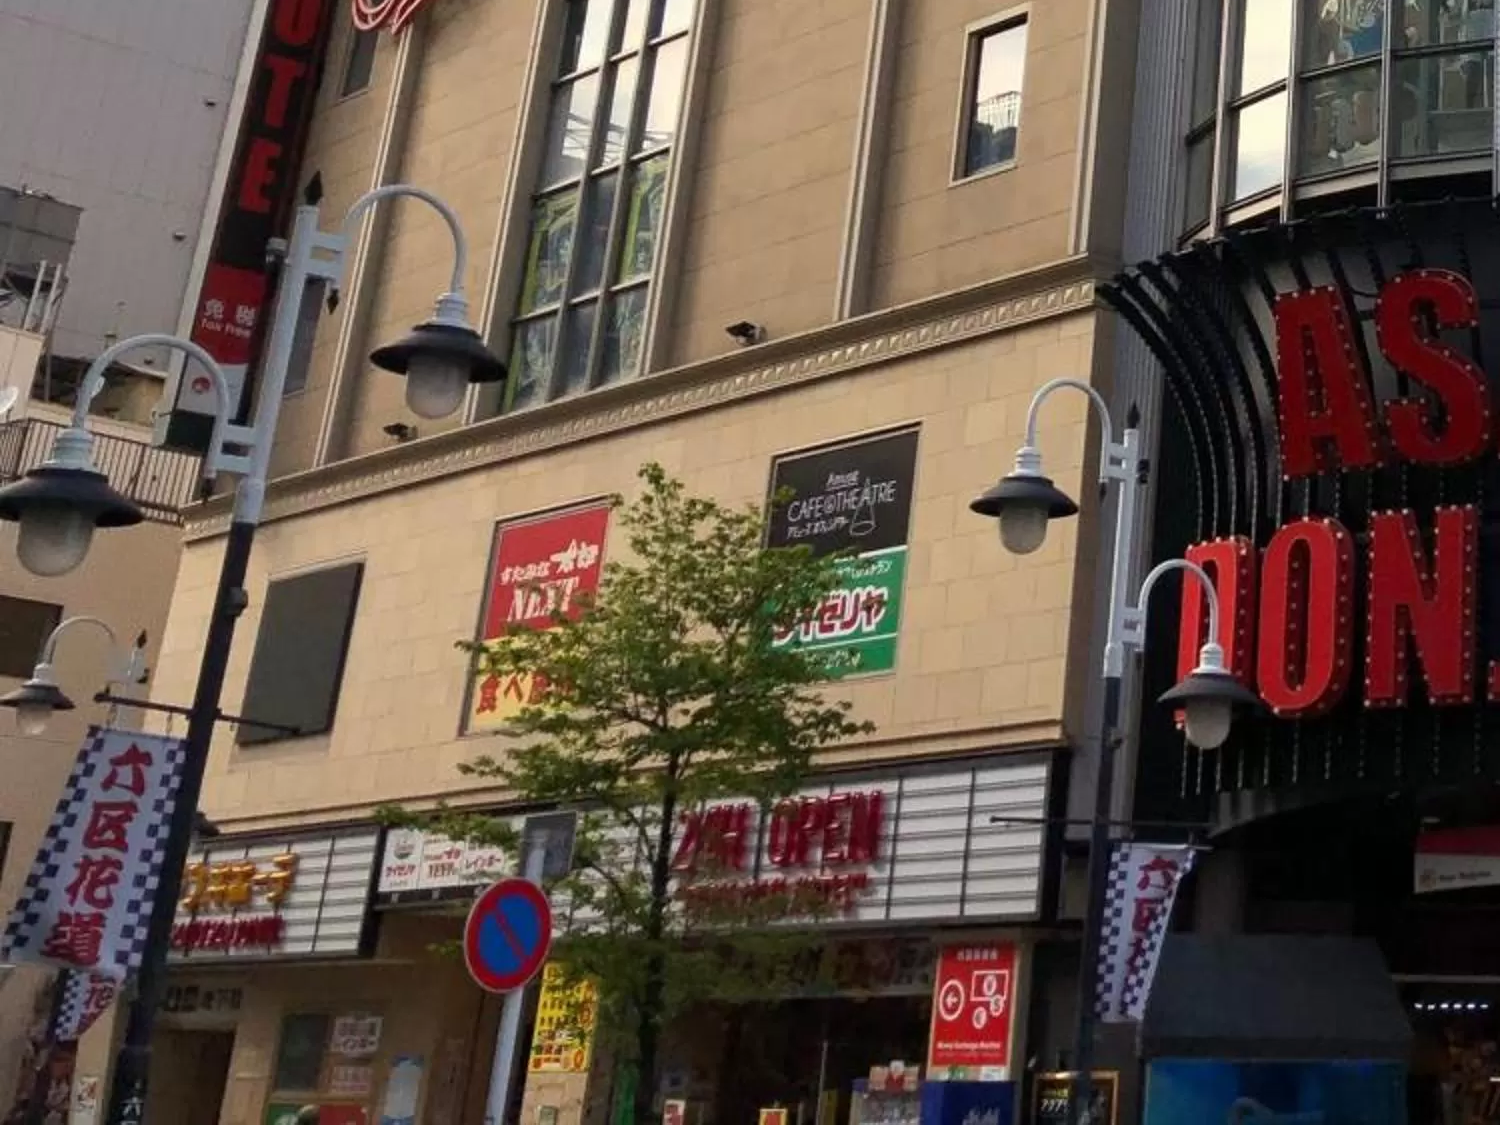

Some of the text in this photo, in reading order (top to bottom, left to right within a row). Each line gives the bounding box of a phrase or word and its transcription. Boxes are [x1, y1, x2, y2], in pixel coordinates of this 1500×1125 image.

[40, 743, 154, 967] 六区花道
[768, 789, 884, 867] OPEN
